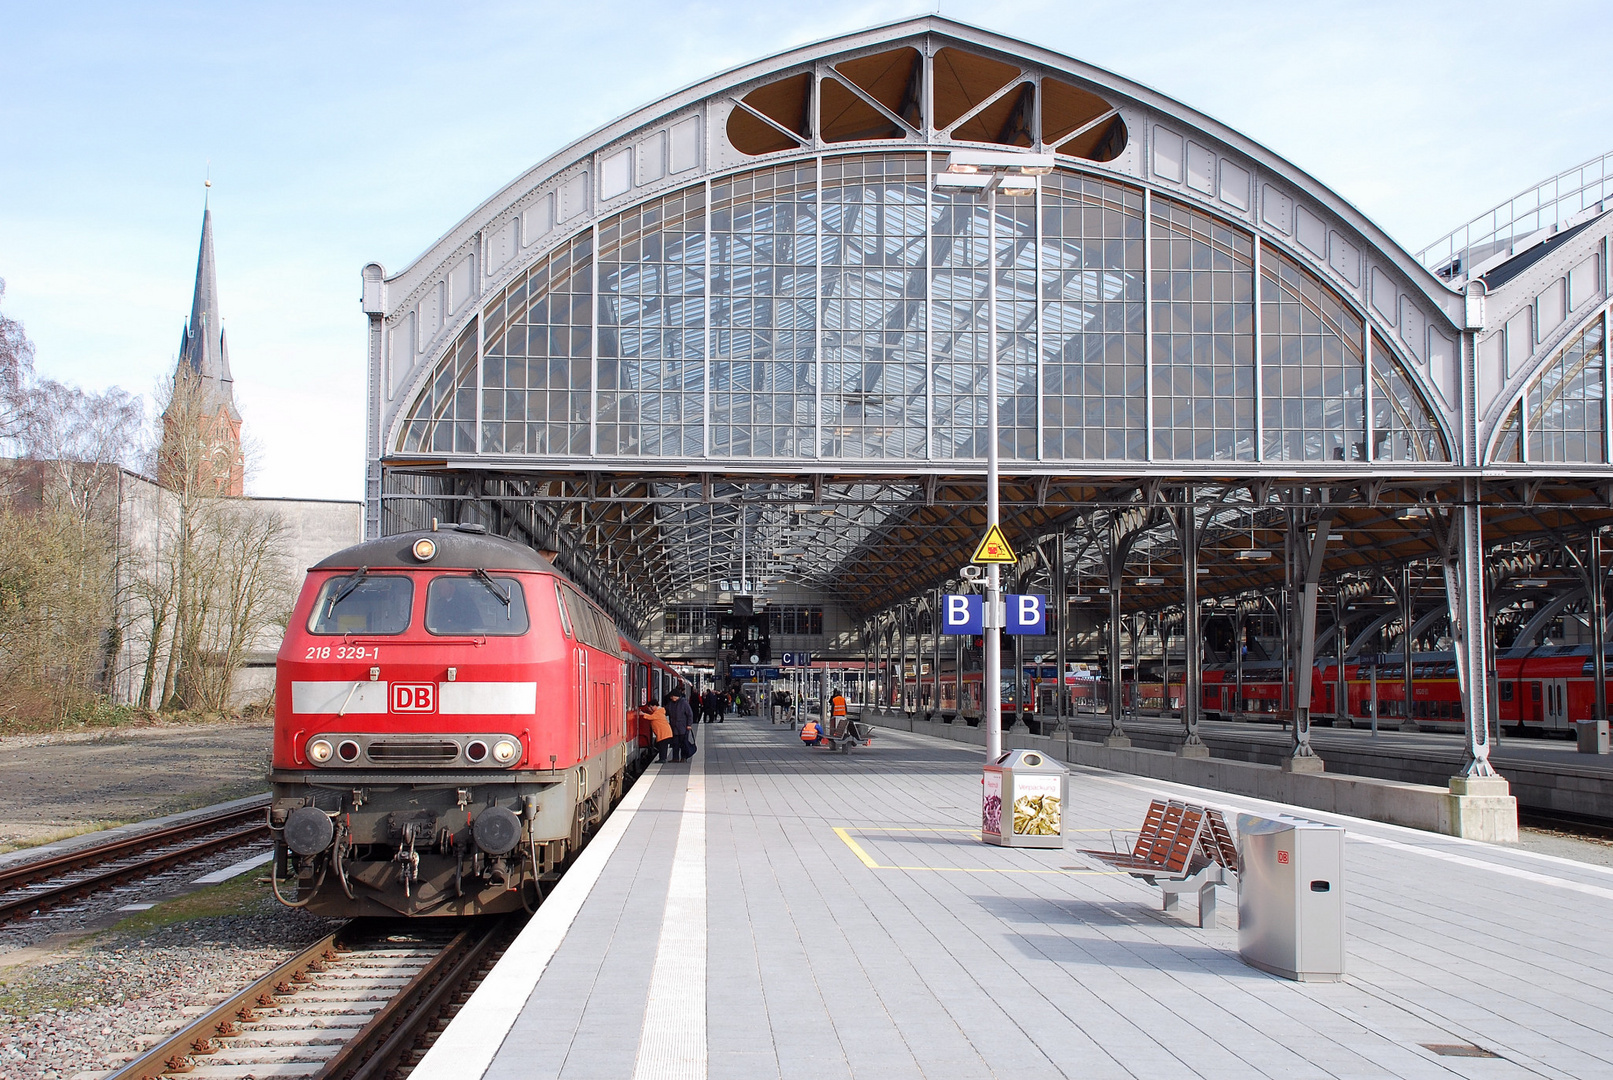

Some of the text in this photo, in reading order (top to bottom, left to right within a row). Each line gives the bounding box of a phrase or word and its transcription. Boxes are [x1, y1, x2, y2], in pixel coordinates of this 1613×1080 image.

[948, 595, 970, 626] B
[1018, 595, 1041, 626] B
[305, 646, 379, 660] 218 329-1
[782, 653, 791, 664] C
[750, 669, 756, 677] D
[396, 687, 431, 709] DB
[1018, 784, 1056, 793] Verpackung
